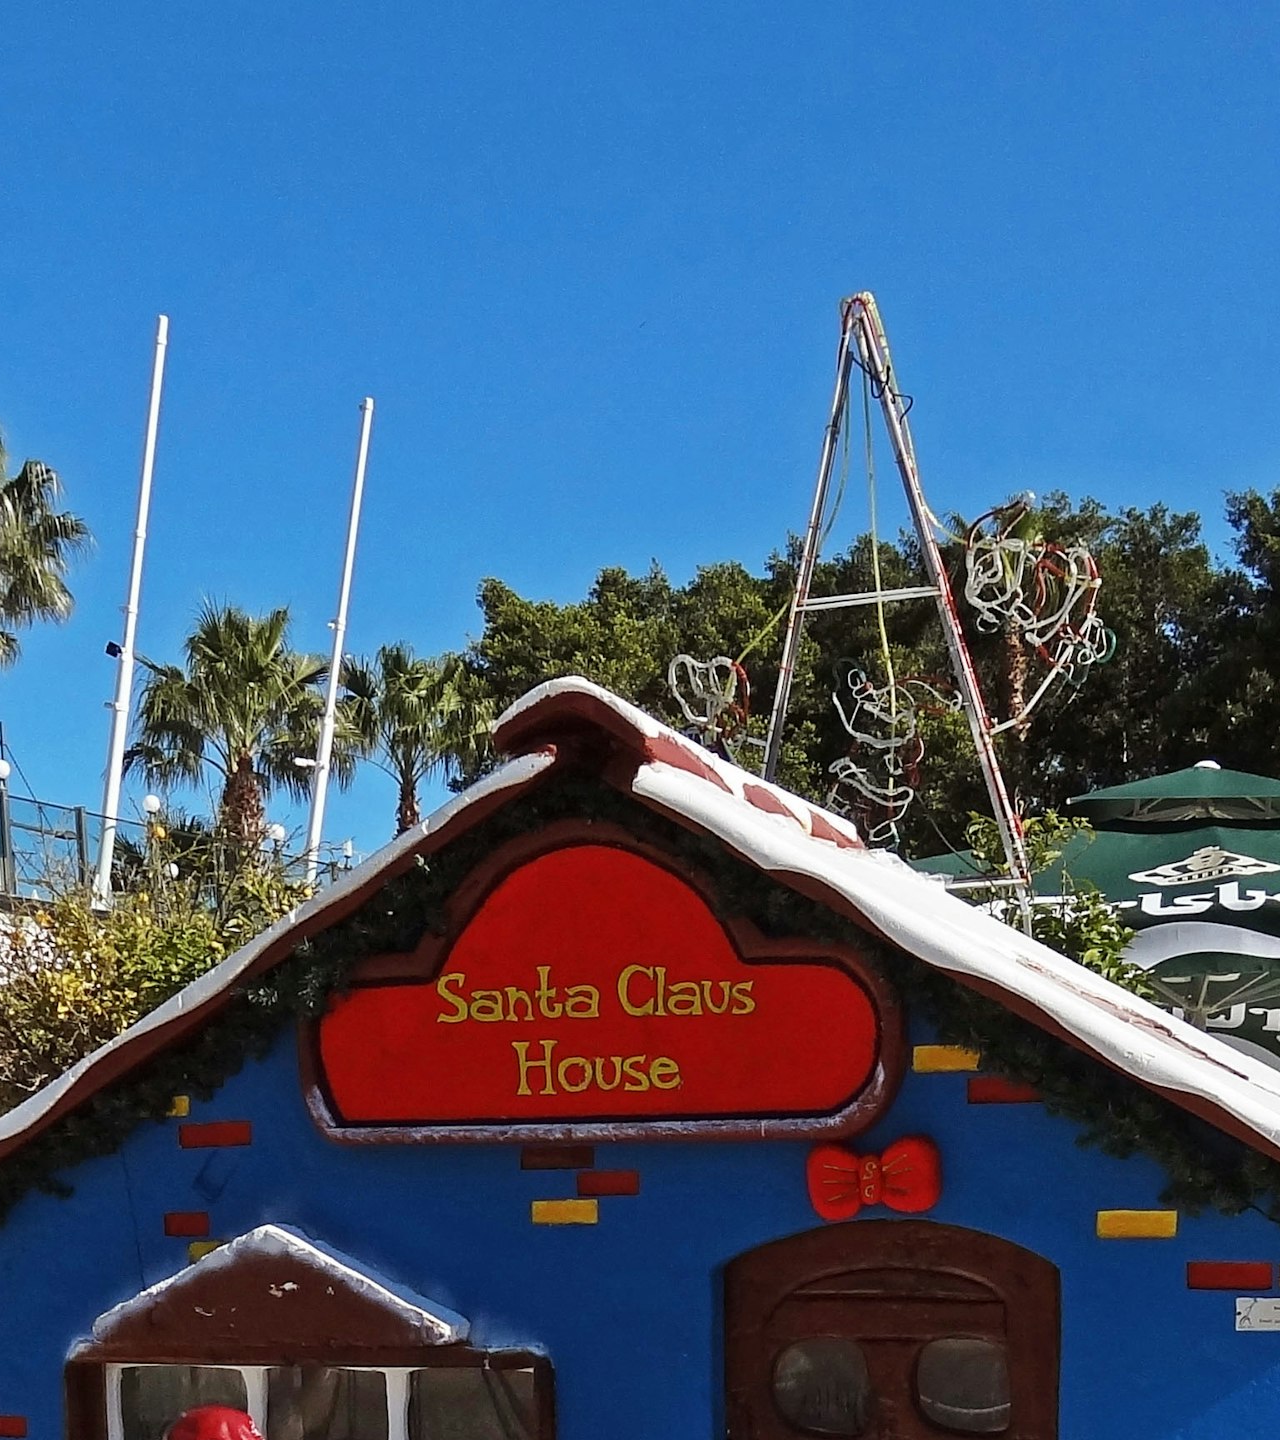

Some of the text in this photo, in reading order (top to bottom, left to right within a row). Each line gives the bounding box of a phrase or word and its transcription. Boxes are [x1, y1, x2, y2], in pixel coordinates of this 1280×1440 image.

[437, 964, 756, 1023] Santa Claus
[512, 1039, 683, 1096] House
